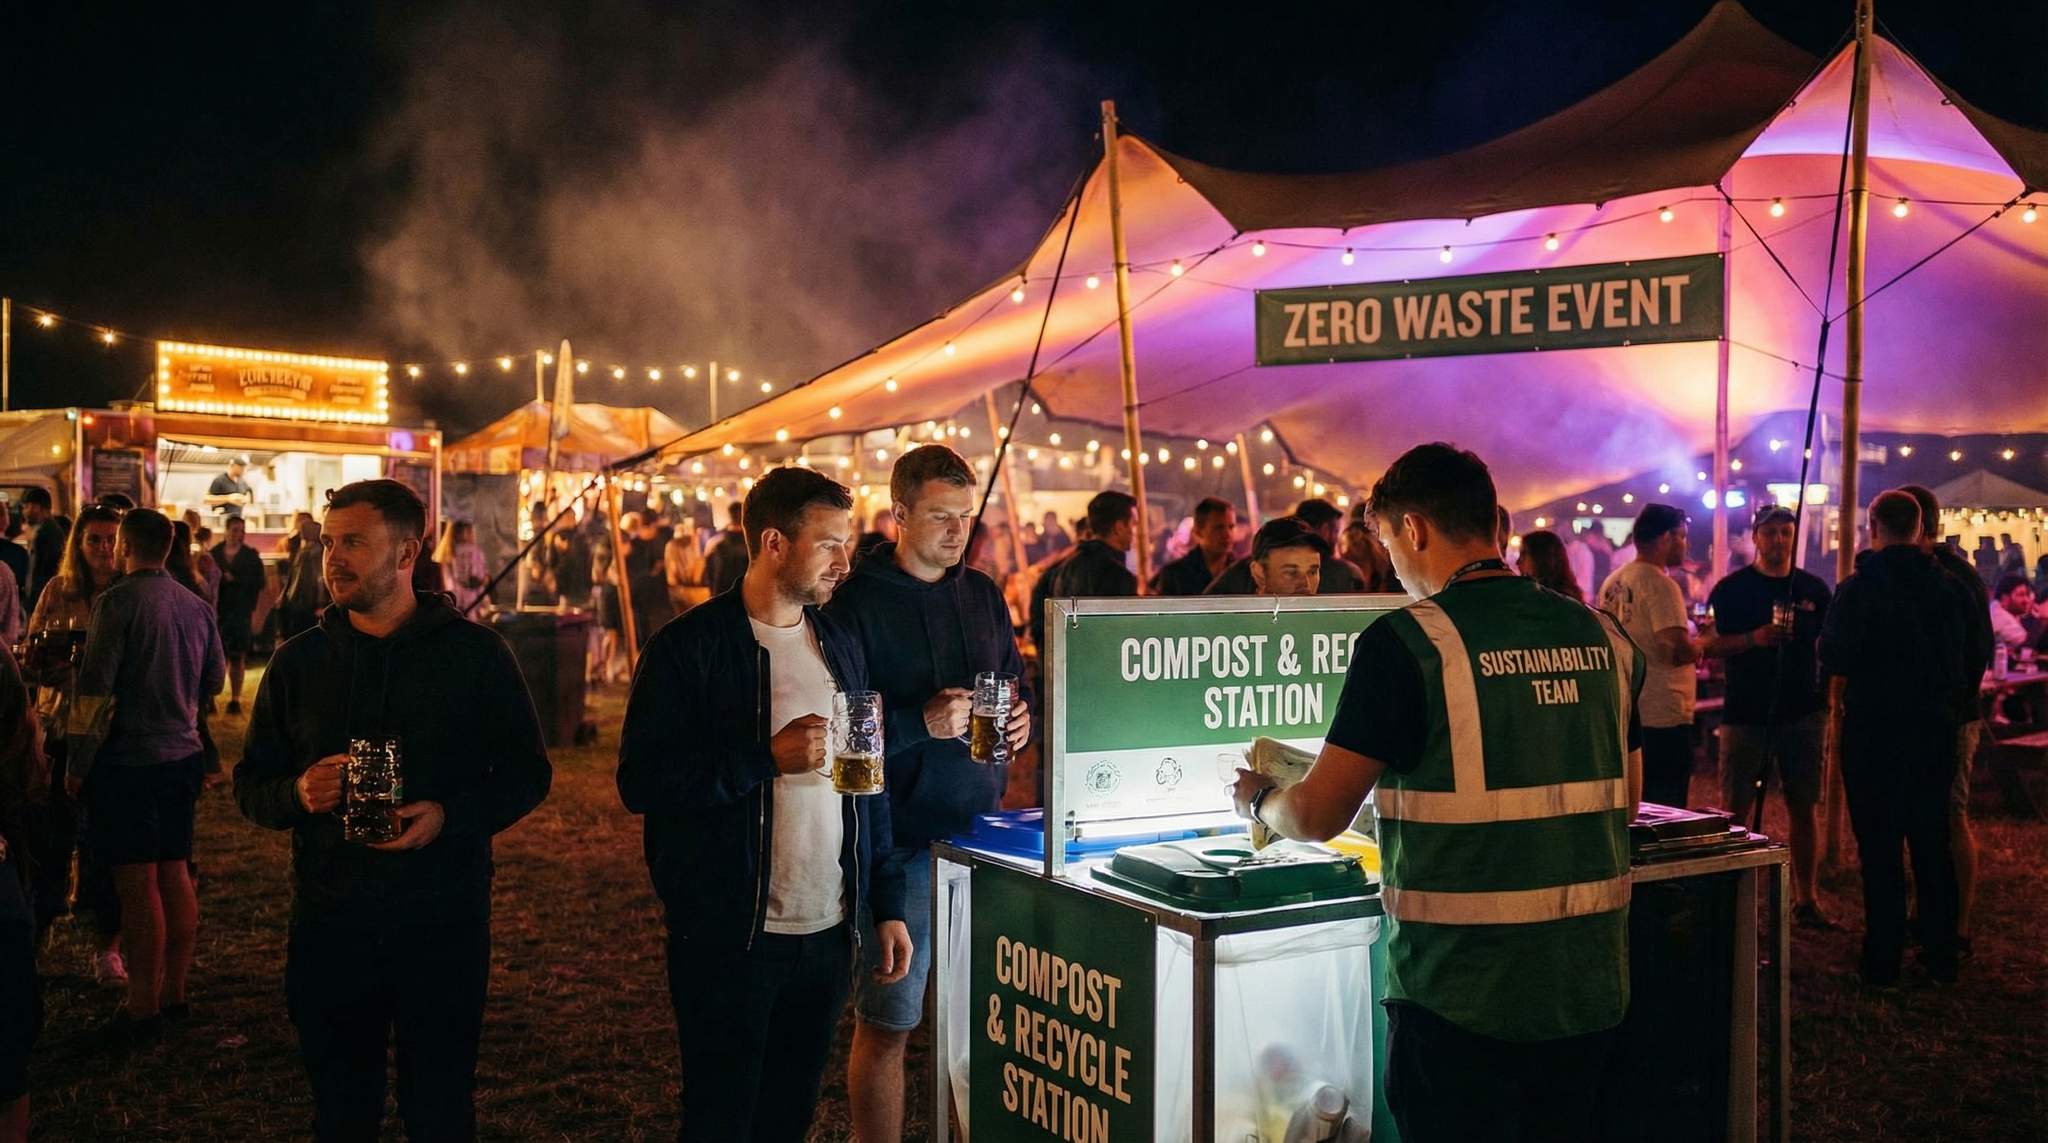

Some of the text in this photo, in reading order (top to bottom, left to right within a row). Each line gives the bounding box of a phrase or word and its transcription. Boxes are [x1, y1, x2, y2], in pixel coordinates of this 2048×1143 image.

[1283, 275, 1690, 348] ZERO WASTE EVENT
[1121, 635, 1268, 682] COMPOST
[1277, 633, 1301, 676] &
[1479, 647, 1610, 677] SUSTAINABILITY
[1204, 683, 1323, 729] STATION
[1532, 679, 1579, 705] TEAM
[996, 935, 1122, 1029] COMPOST
[987, 993, 1131, 1104] & RECYCLE
[1003, 1062, 1110, 1143] STATION
